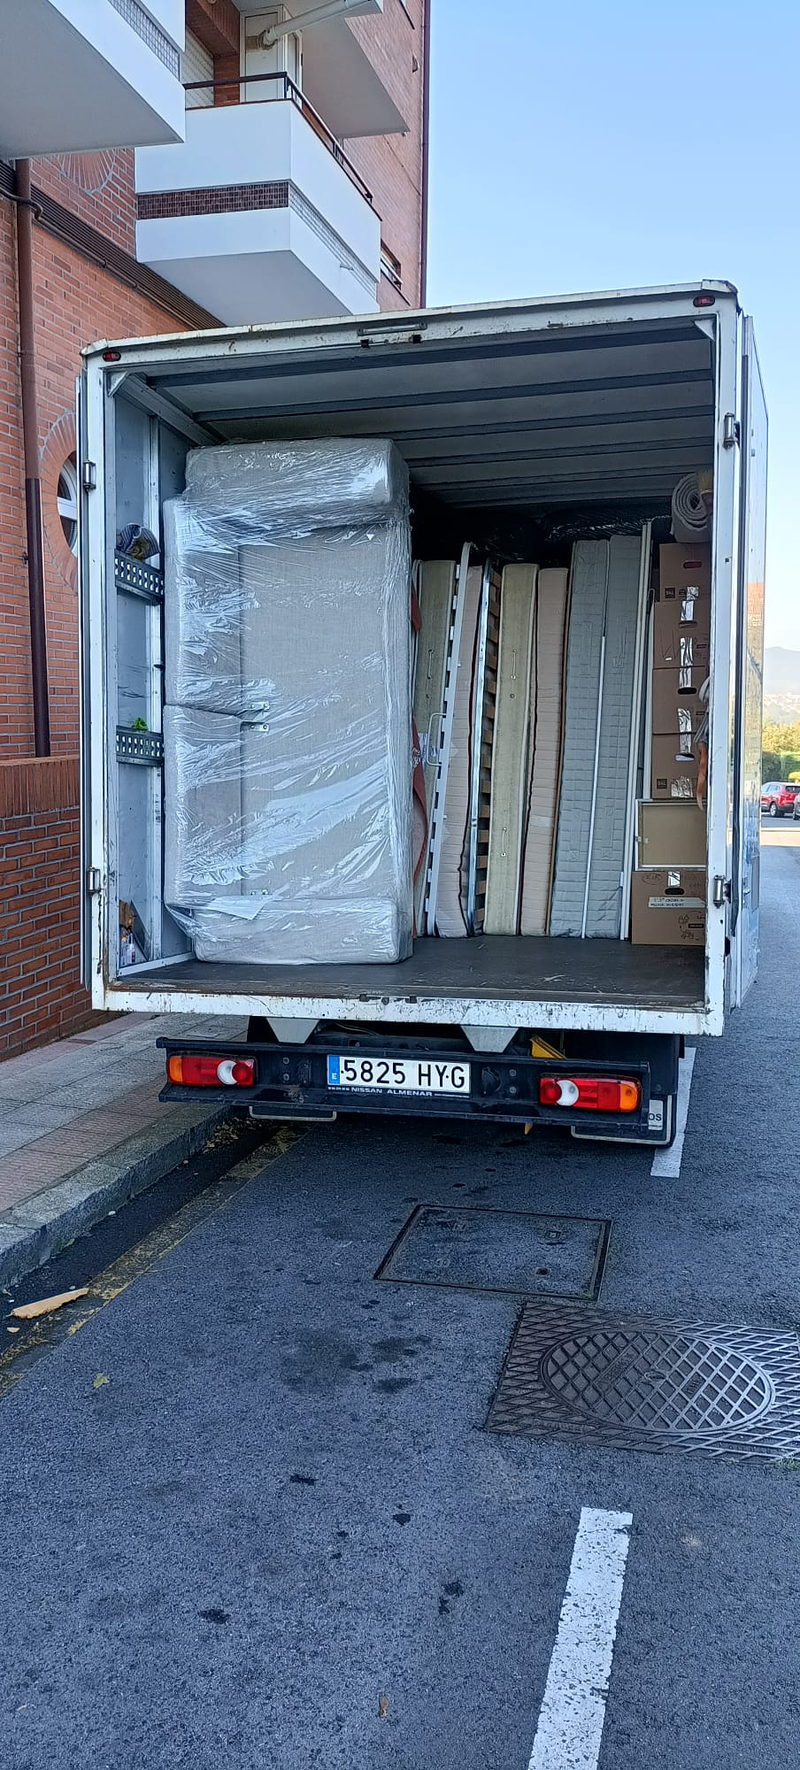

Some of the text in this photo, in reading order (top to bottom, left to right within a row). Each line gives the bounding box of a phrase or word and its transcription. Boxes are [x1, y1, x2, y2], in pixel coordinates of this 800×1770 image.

[331, 1072, 338, 1080] E
[343, 1059, 465, 1089] 5825 HYG
[386, 1088, 433, 1097] ALMENAR
[648, 1113, 662, 1121] OS
